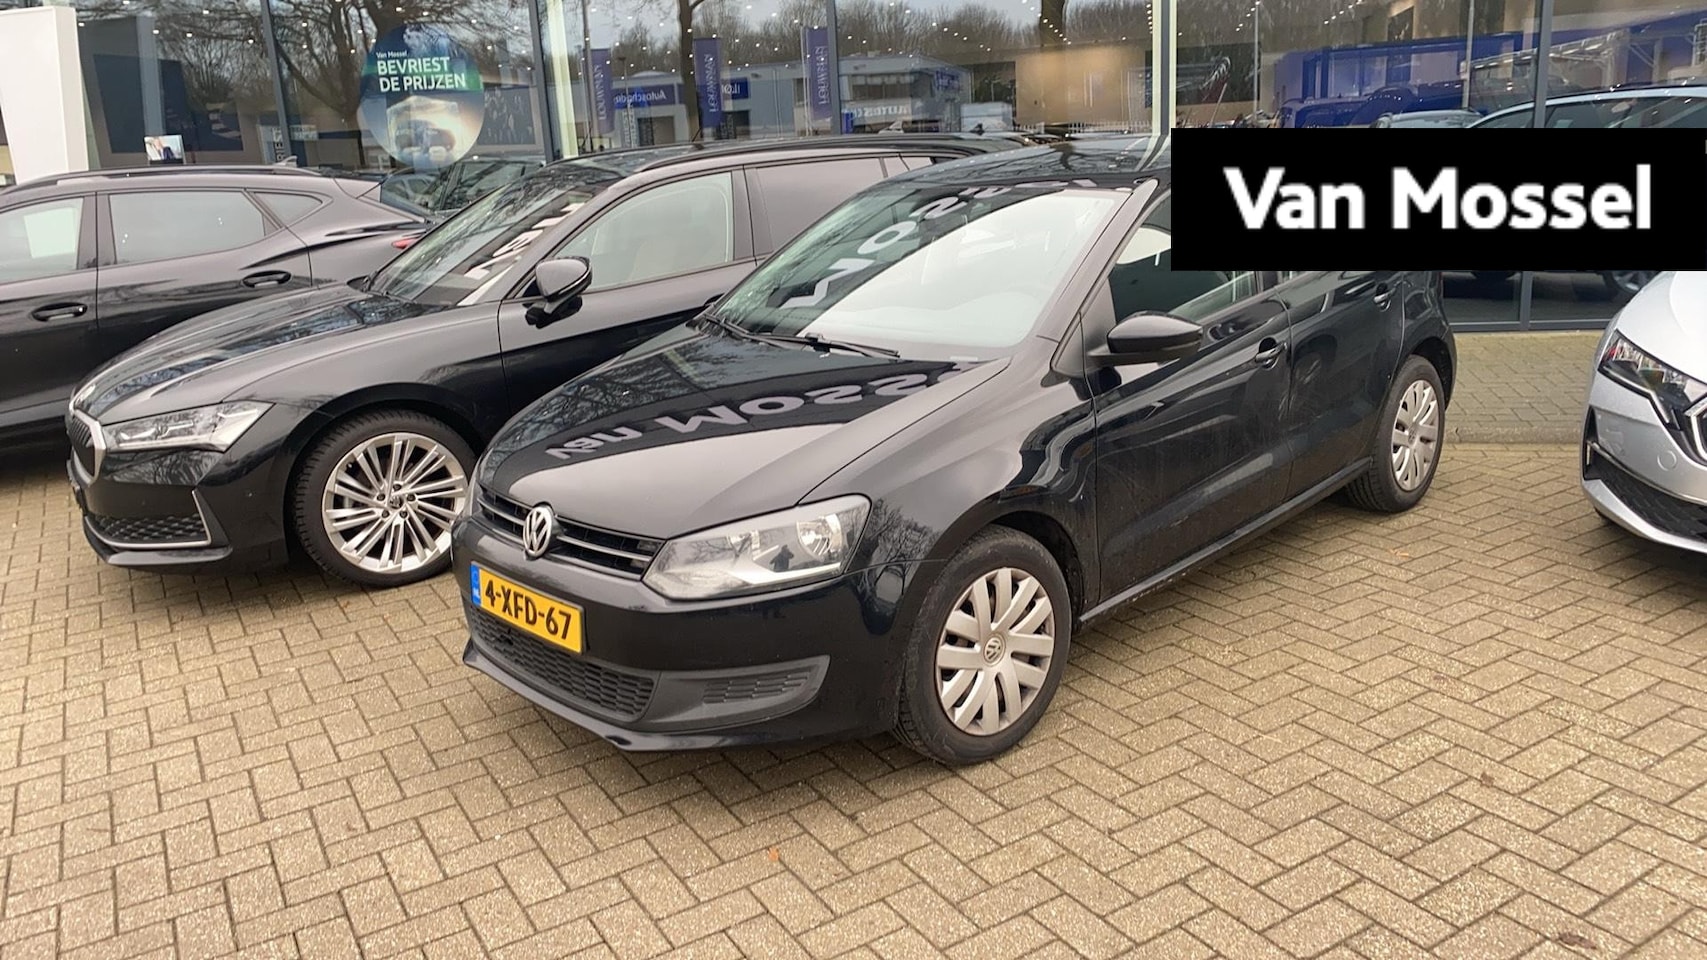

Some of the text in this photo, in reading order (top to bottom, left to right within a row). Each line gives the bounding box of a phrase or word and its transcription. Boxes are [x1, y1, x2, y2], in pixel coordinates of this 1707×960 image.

[376, 50, 408, 59] Van Mossel
[377, 56, 450, 76] BEVRIEST
[379, 73, 467, 92] DE PRIJZEN
[485, 579, 572, 640] 4-XFD-67
